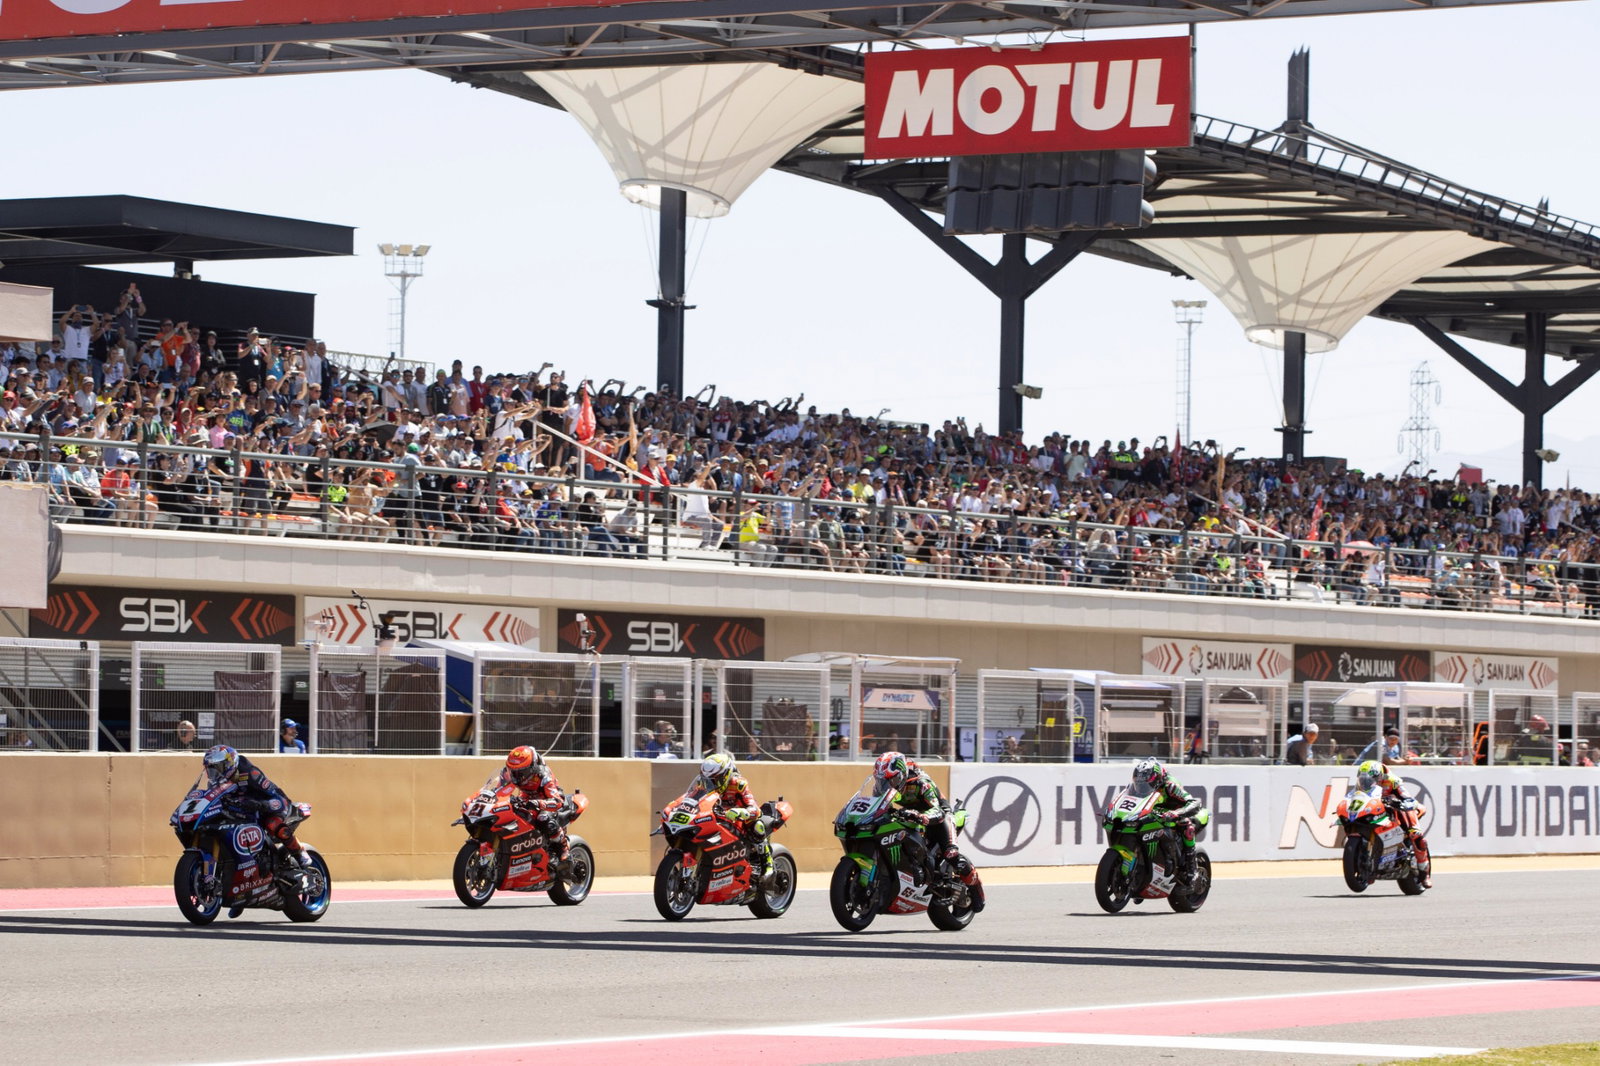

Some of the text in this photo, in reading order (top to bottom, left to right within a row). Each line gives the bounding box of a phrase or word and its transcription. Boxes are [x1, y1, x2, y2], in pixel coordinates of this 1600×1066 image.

[877, 58, 1175, 139] MOTUL
[119, 596, 209, 634] SBK
[380, 610, 463, 642] SBK
[627, 620, 697, 654] SBK
[1206, 651, 1252, 671] SAN JUAN
[1353, 658, 1396, 678] SAN JUAN
[1487, 663, 1525, 681] SAN JUAN
[182, 800, 202, 814] 1
[468, 803, 486, 817] 21
[1056, 785, 1251, 845] HYAI
[1119, 800, 1136, 811] 22
[1446, 785, 1600, 837] HYUNDAI
[511, 833, 543, 853] aruba
[880, 832, 898, 846] elf
[1142, 831, 1156, 841] elf
[512, 855, 532, 865] Lenovo
[713, 845, 747, 865] aruba
[713, 868, 734, 879] Lenovo
[901, 886, 916, 898] 65
